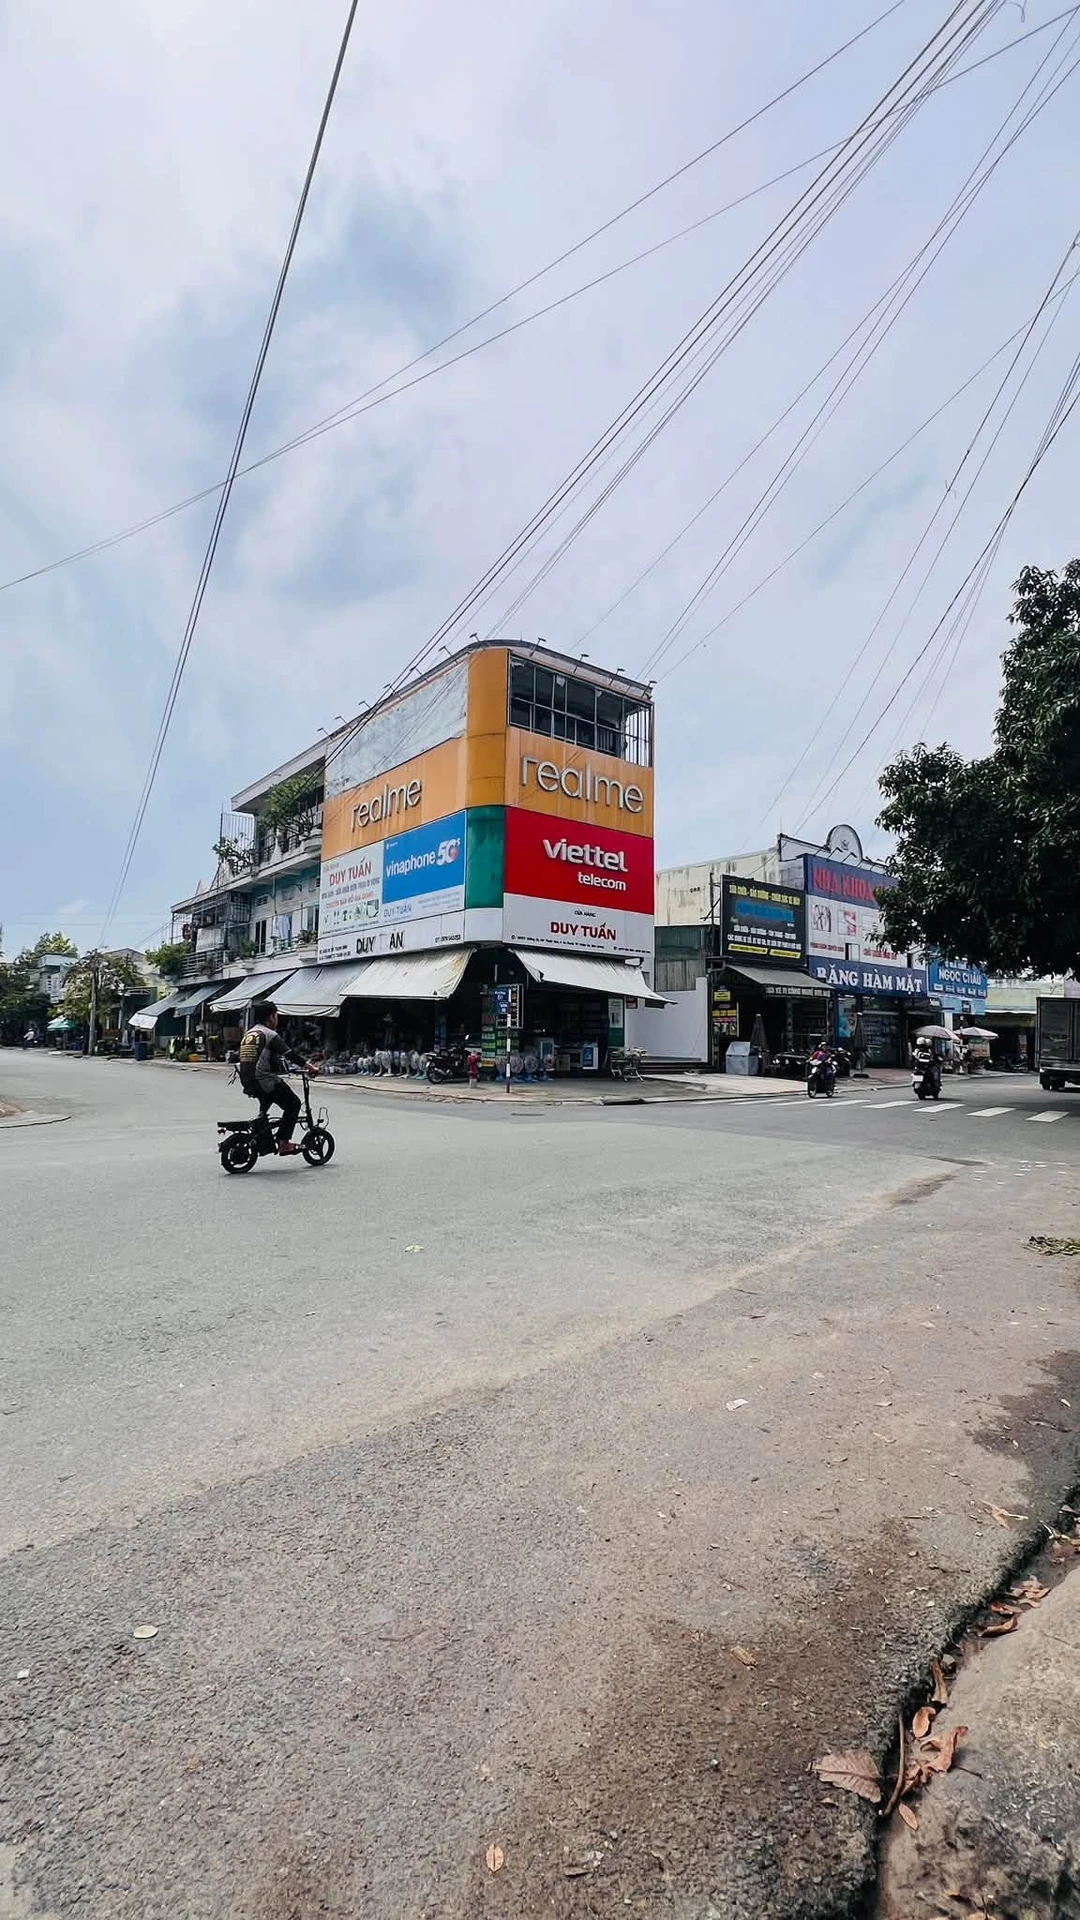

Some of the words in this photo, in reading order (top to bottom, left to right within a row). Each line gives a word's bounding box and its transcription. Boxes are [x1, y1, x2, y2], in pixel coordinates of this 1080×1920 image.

[521, 756, 645, 814] realme
[350, 778, 423, 832] realme
[386, 850, 435, 879] vinaphone
[543, 838, 629, 873] viettel
[329, 868, 348, 888] DUY
[348, 856, 372, 880] TUẤN
[577, 871, 627, 892] telecom
[812, 866, 840, 893] NHA
[355, 936, 376, 955] DUY
[550, 921, 580, 936] DUY
[581, 922, 617, 941] TUẤN
[816, 964, 859, 986] RĂNG
[863, 969, 893, 988] HÀM
[895, 974, 922, 995] MẶT
